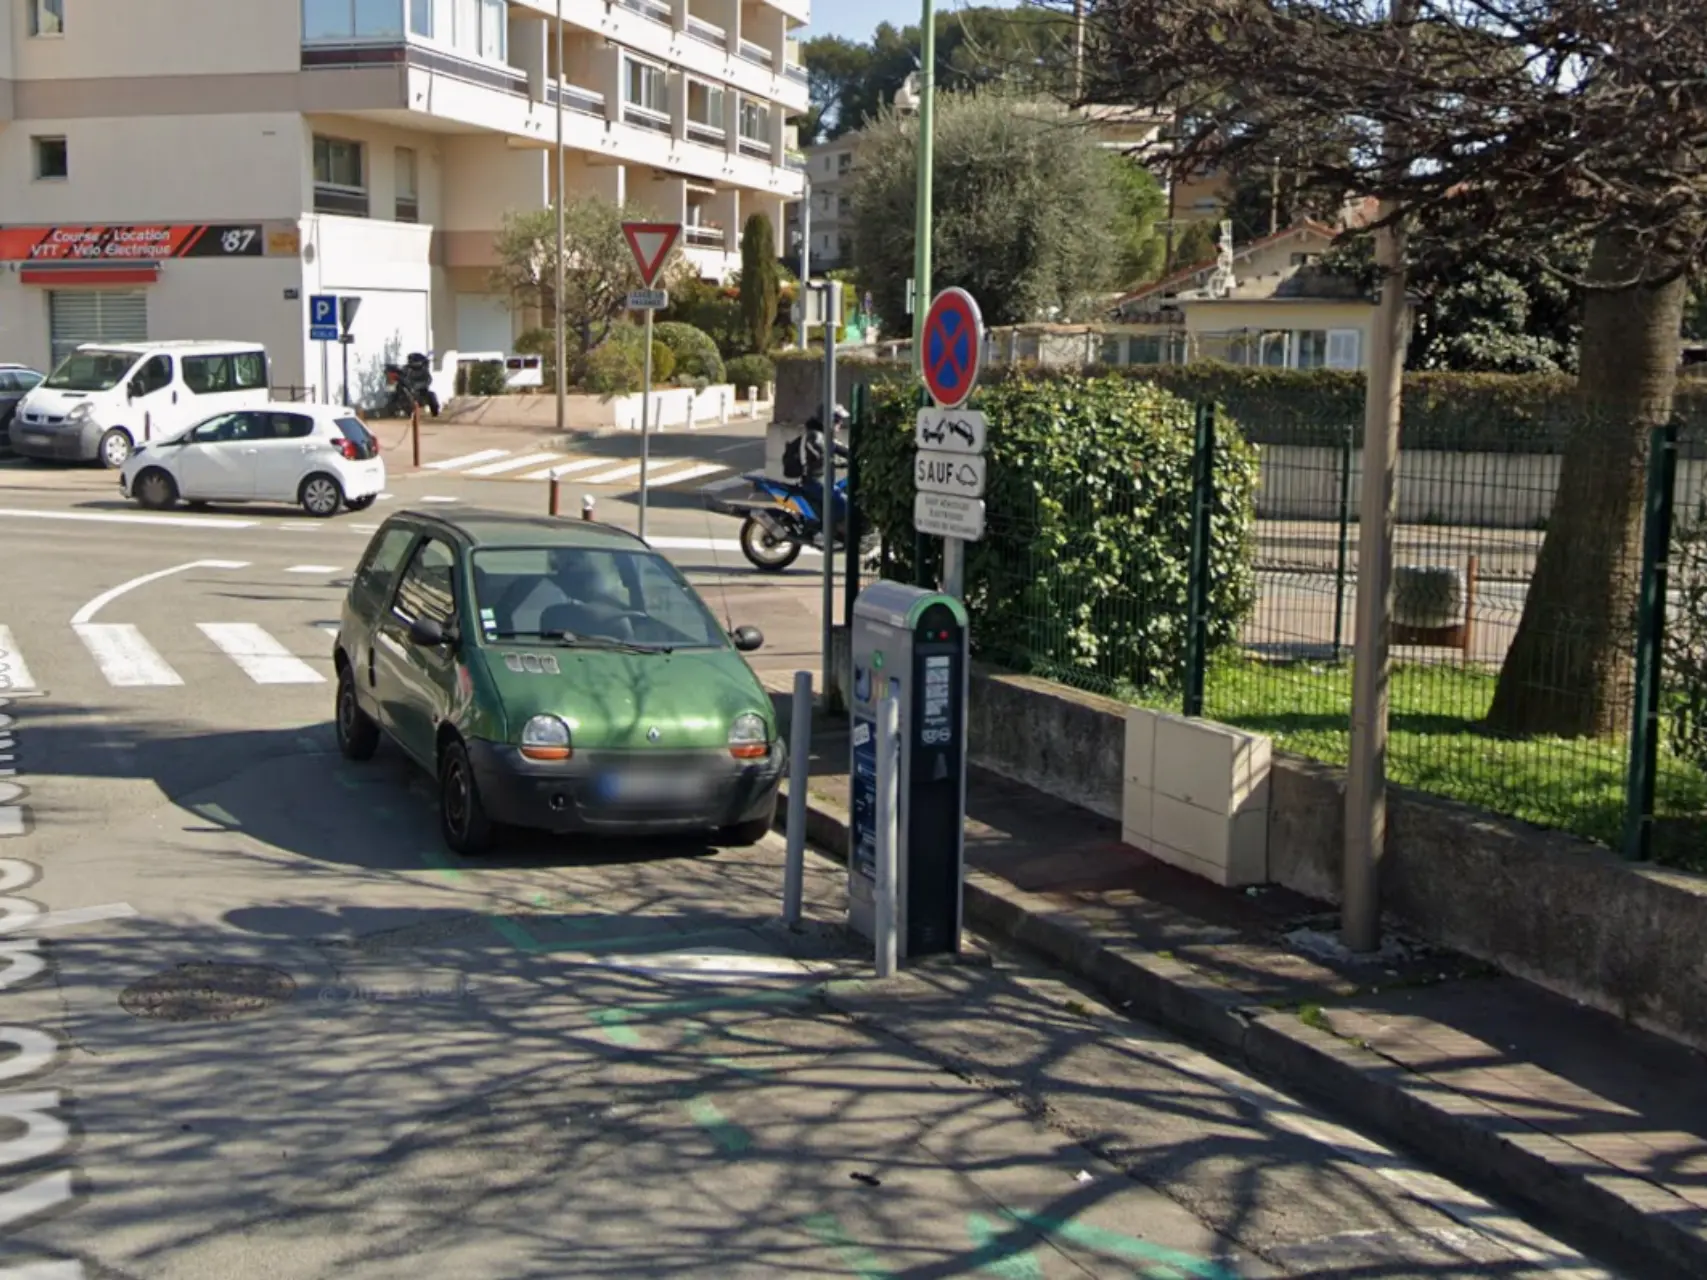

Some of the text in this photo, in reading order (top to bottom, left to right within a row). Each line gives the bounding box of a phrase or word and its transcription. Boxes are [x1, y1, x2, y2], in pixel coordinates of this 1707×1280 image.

[53, 229, 100, 242] Course
[114, 228, 170, 241] Location
[31, 243, 58, 256] VTT
[316, 300, 330, 321] P
[918, 460, 953, 484] SAUF
